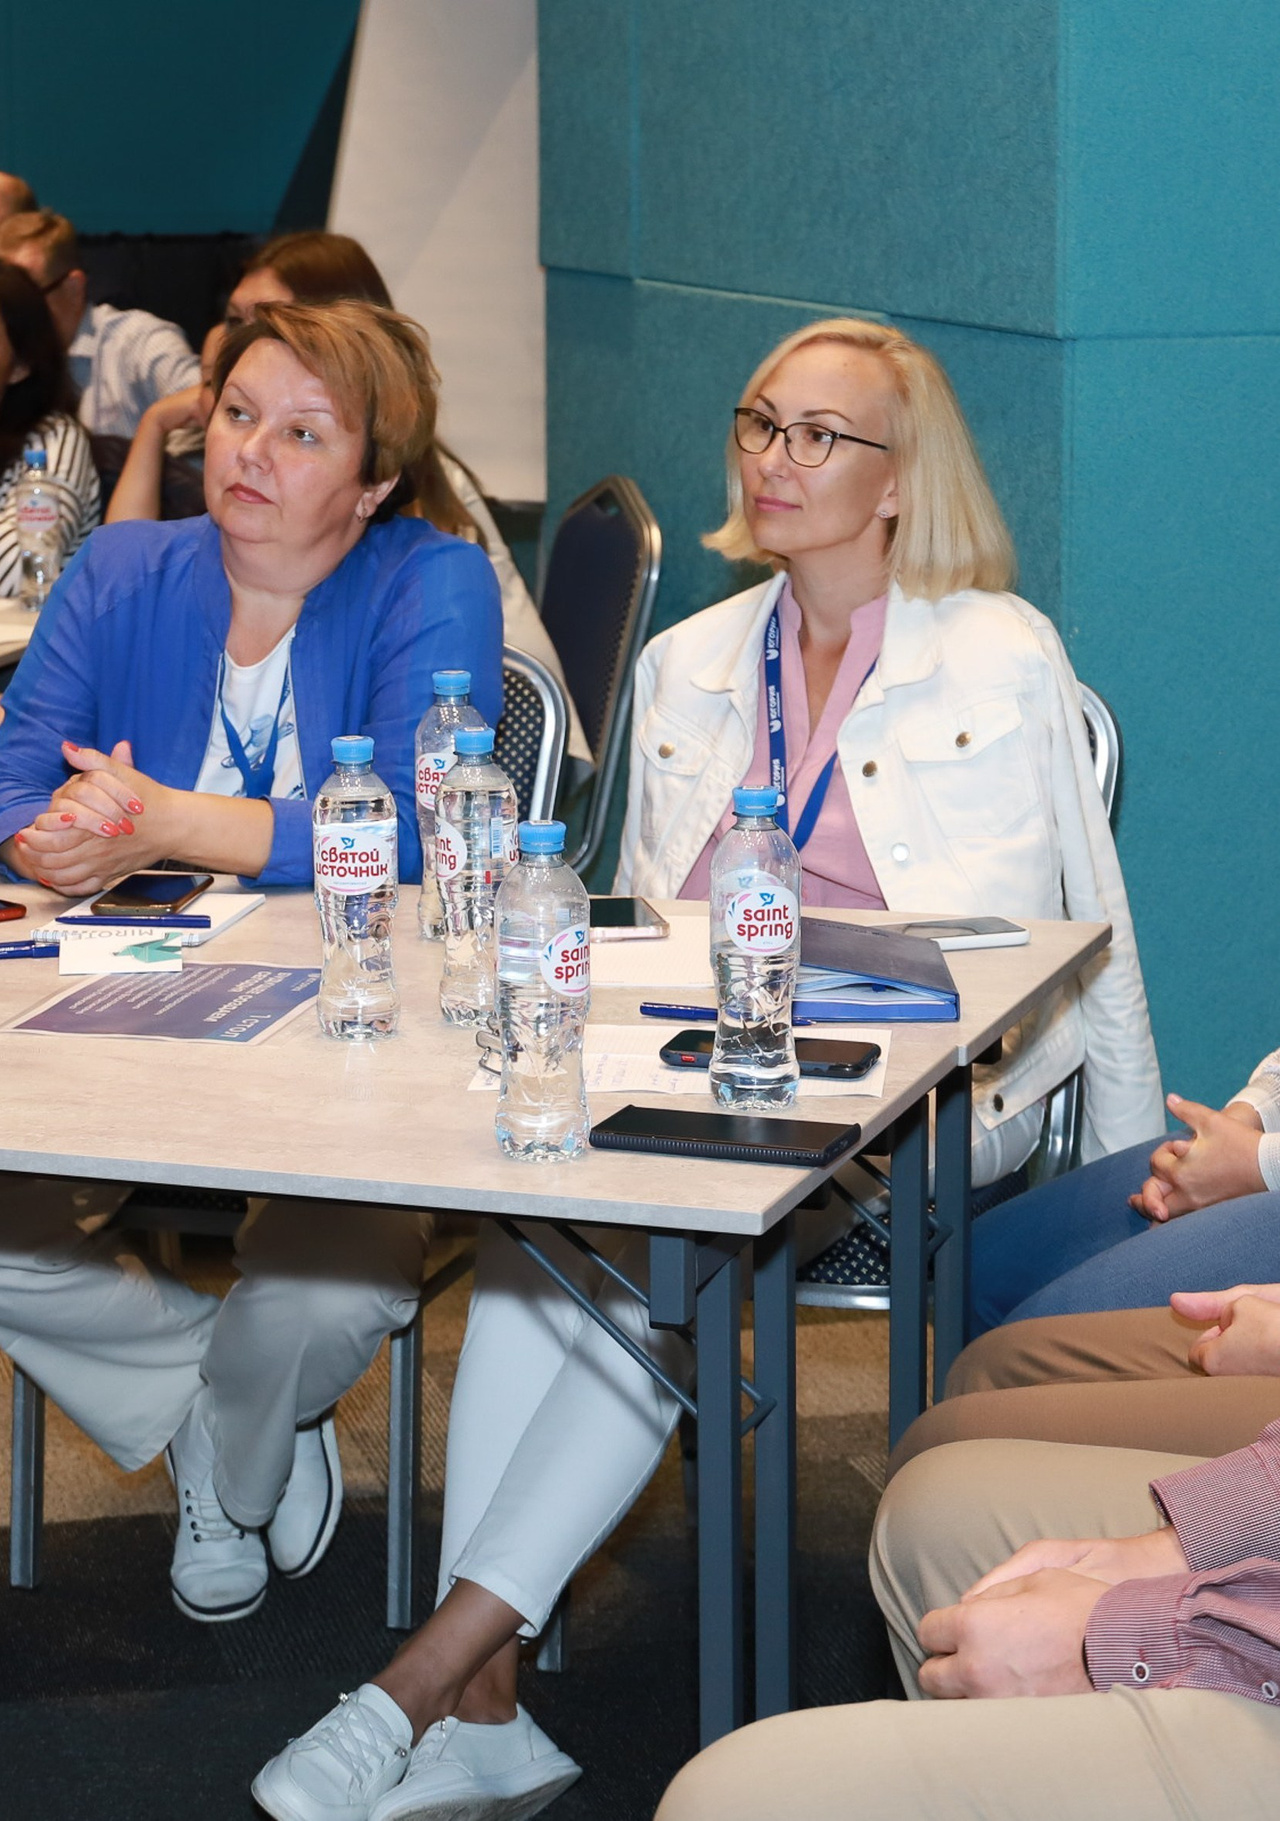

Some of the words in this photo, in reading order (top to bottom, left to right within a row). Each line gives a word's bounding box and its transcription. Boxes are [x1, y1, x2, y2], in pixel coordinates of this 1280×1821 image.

[743, 905, 789, 922] saint
[737, 921, 793, 942] spring
[220, 1019, 260, 1037] СТОЛ
